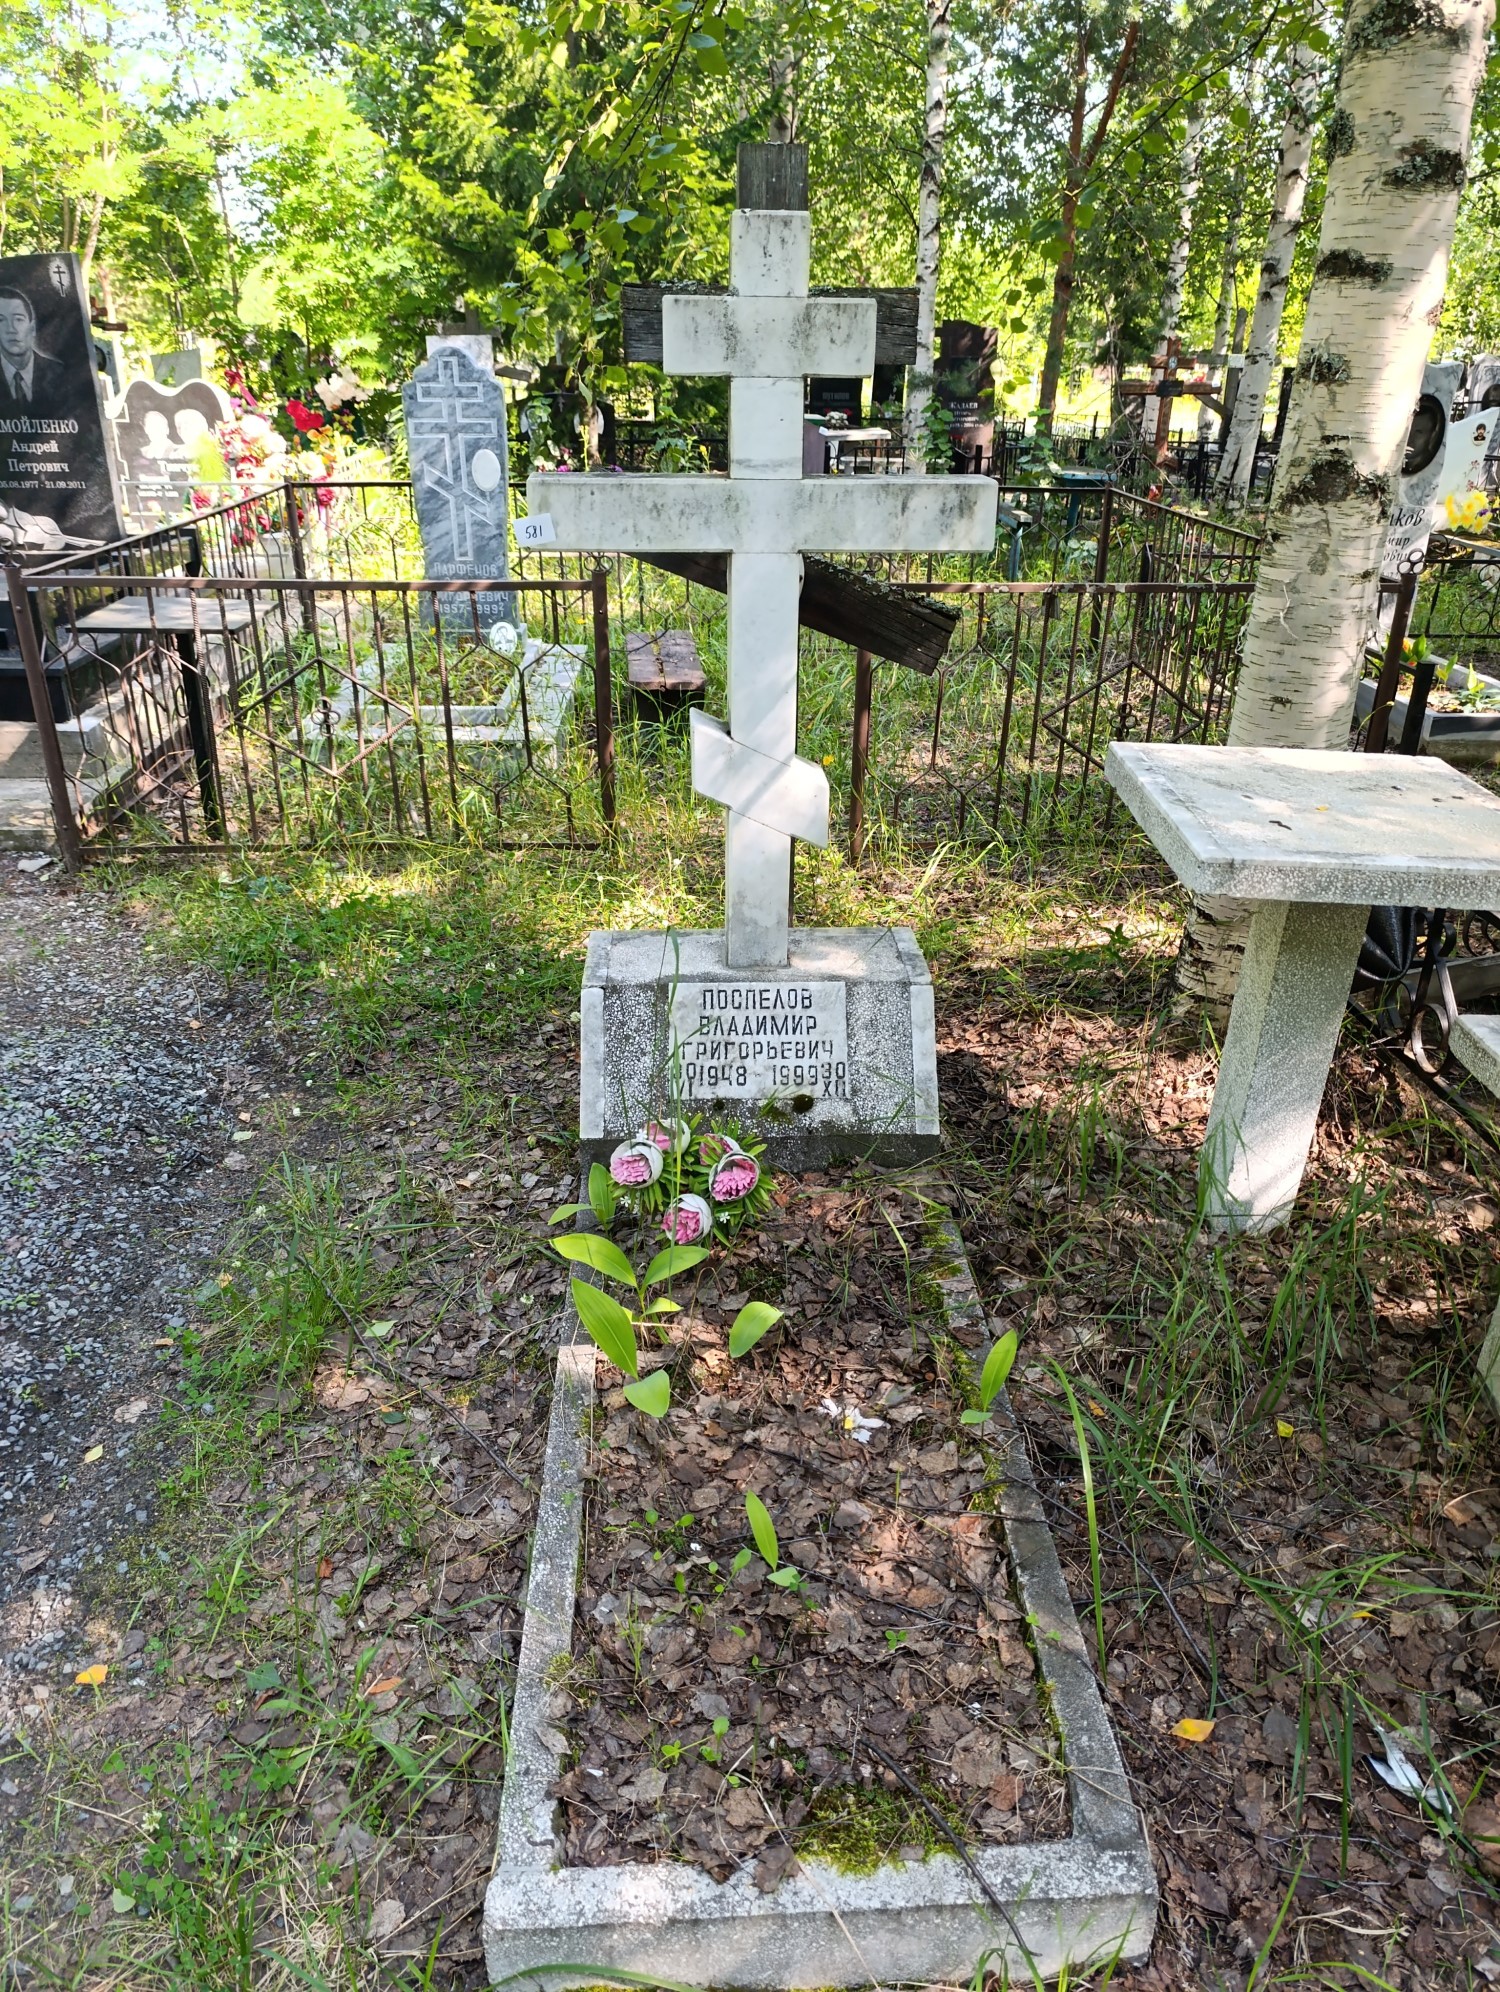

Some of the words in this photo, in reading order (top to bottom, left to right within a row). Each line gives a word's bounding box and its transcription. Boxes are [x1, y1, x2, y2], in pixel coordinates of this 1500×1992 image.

[0, 415, 79, 434] МОЙЛЕНКО
[11, 439, 60, 455] Андрей
[7, 458, 70, 475] Петрович
[525, 525, 543, 539] 581
[433, 562, 498, 577] ПАРФЕНОВ
[702, 988, 813, 1010] ПОСПЕЛОВ
[699, 1015, 817, 1036] ВЛАДИМИР
[681, 1039, 833, 1060] ГРИГОРЬЕВИЧ
[699, 1064, 748, 1087] 1948
[772, 1064, 818, 1086] 1999
[820, 1061, 846, 1080] 30
